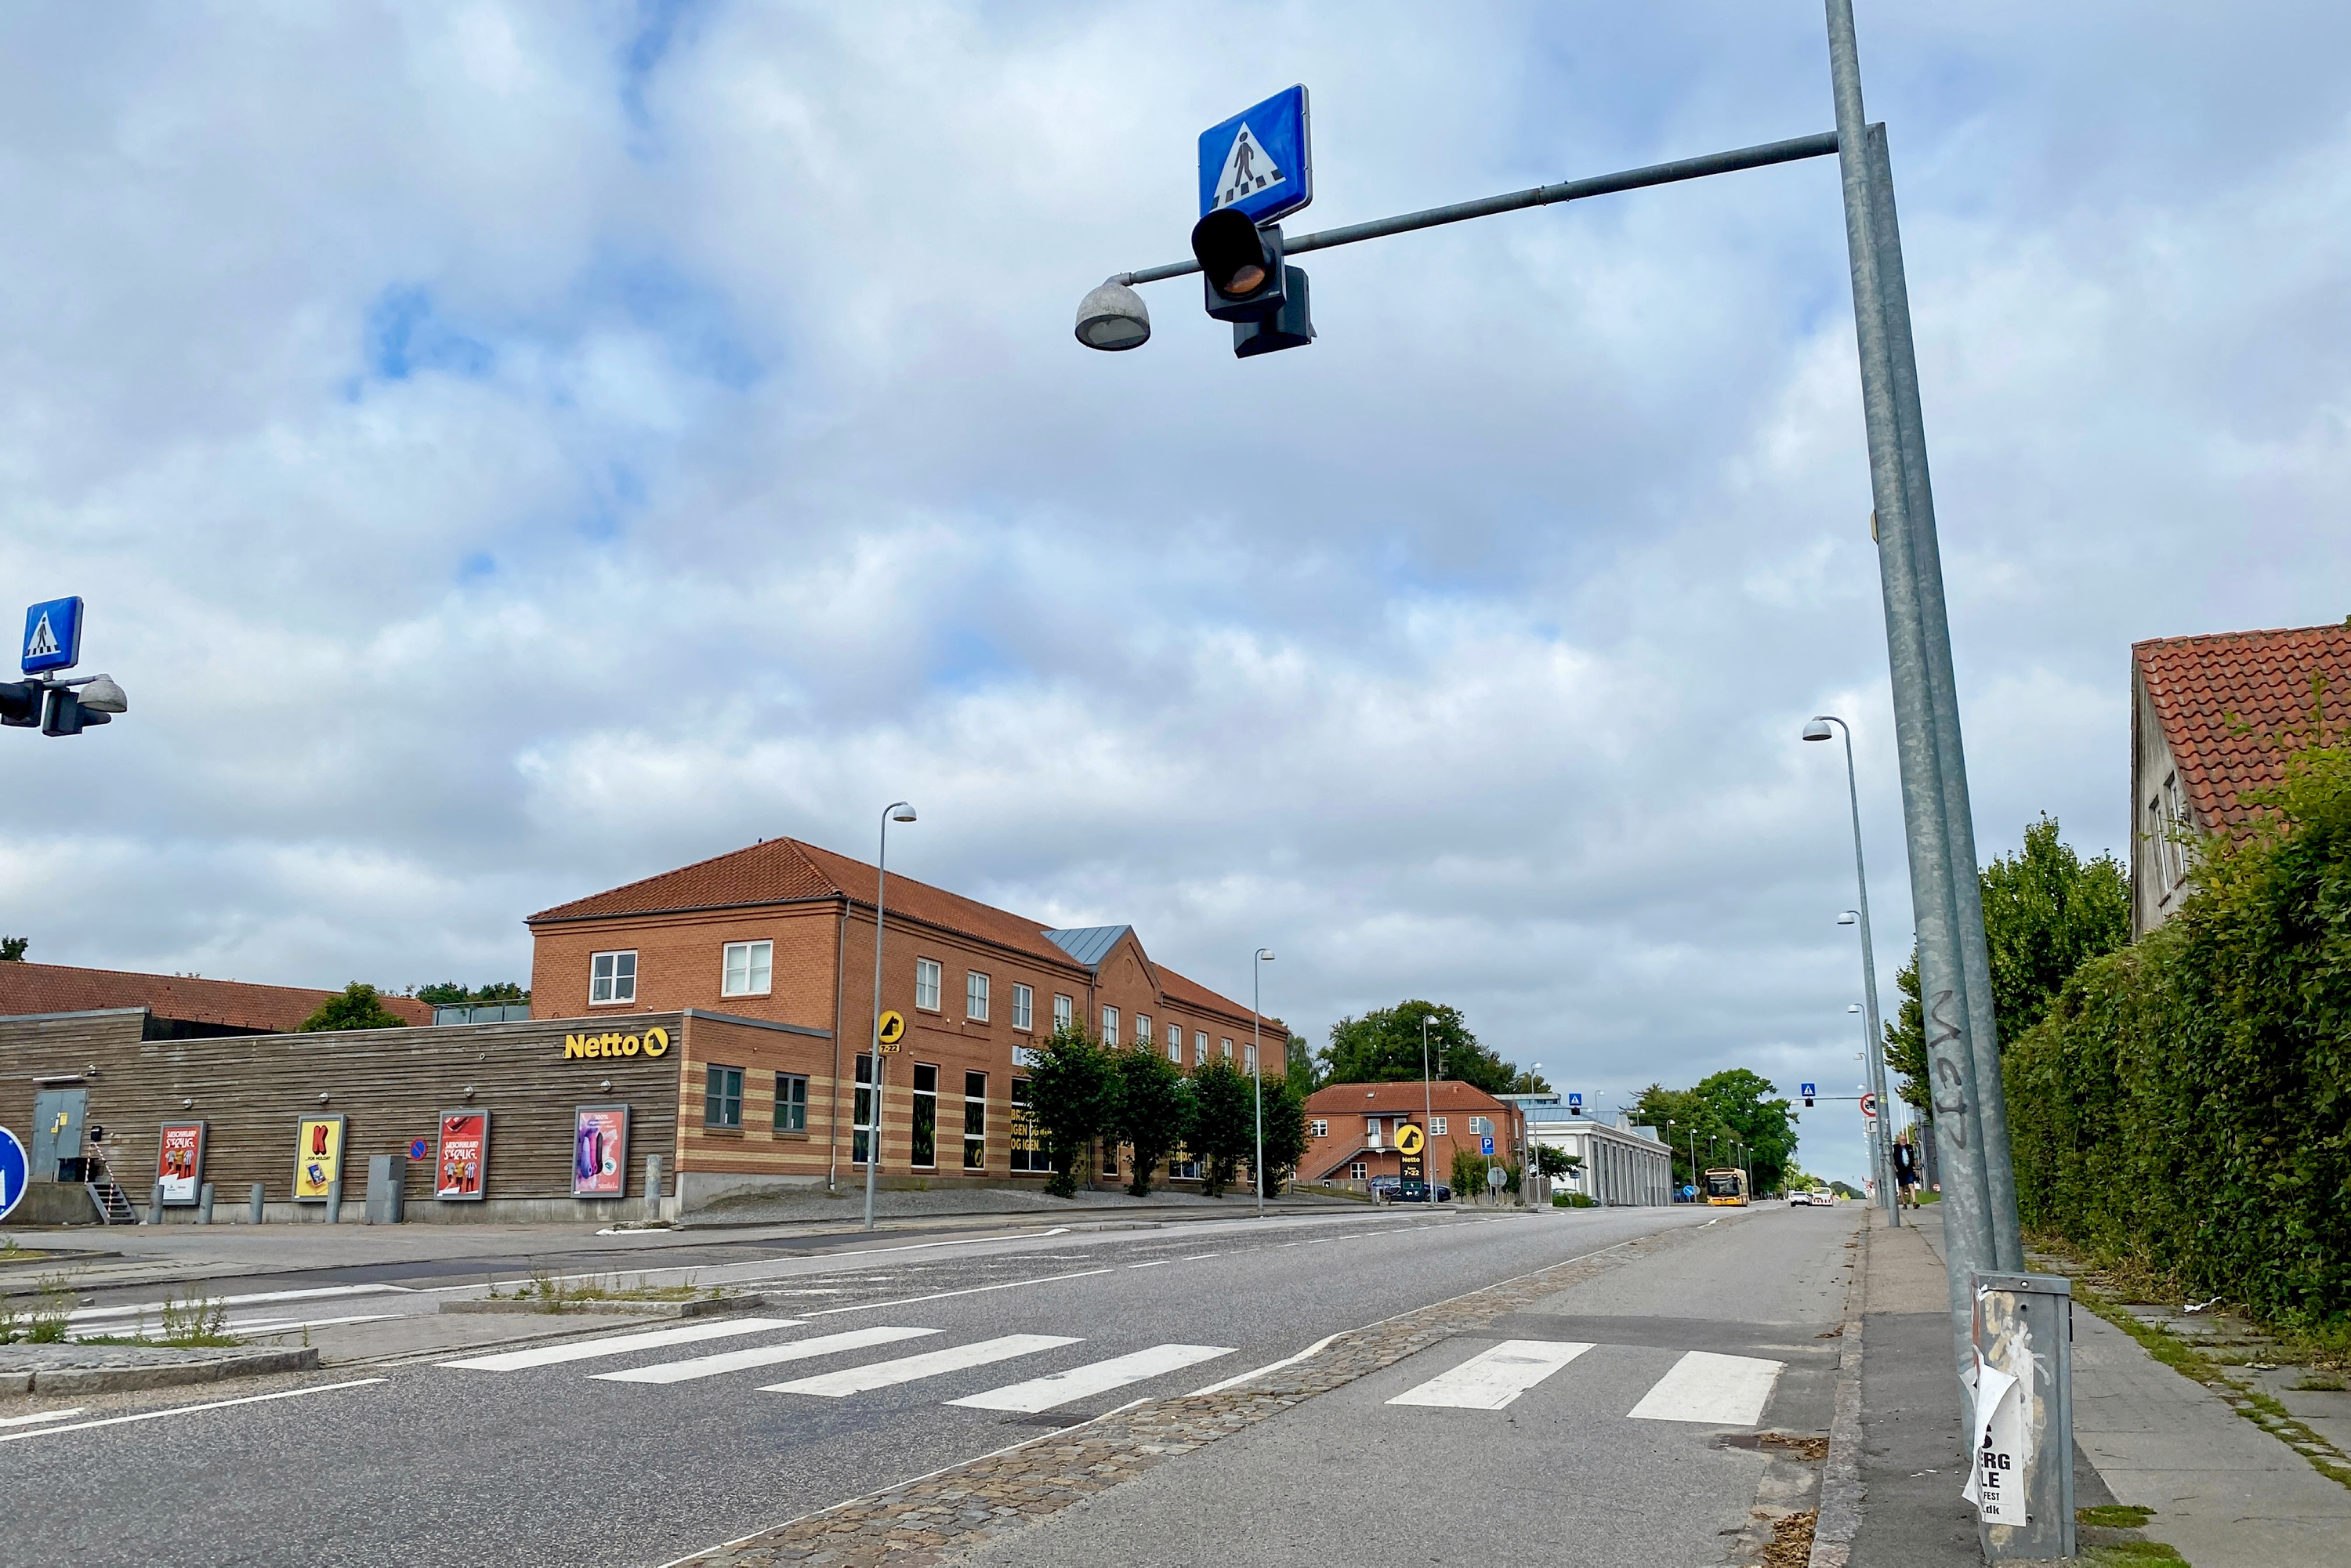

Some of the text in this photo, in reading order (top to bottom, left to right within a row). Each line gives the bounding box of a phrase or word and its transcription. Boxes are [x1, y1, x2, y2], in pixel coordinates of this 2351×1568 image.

[565, 1032, 639, 1059] Netto
[1011, 1123, 1027, 1136] IGEN
[312, 1125, 328, 1155] K
[1011, 1138, 1021, 1150] OG
[1484, 1139, 1491, 1149] P
[1983, 1491, 2000, 1501] FEST
